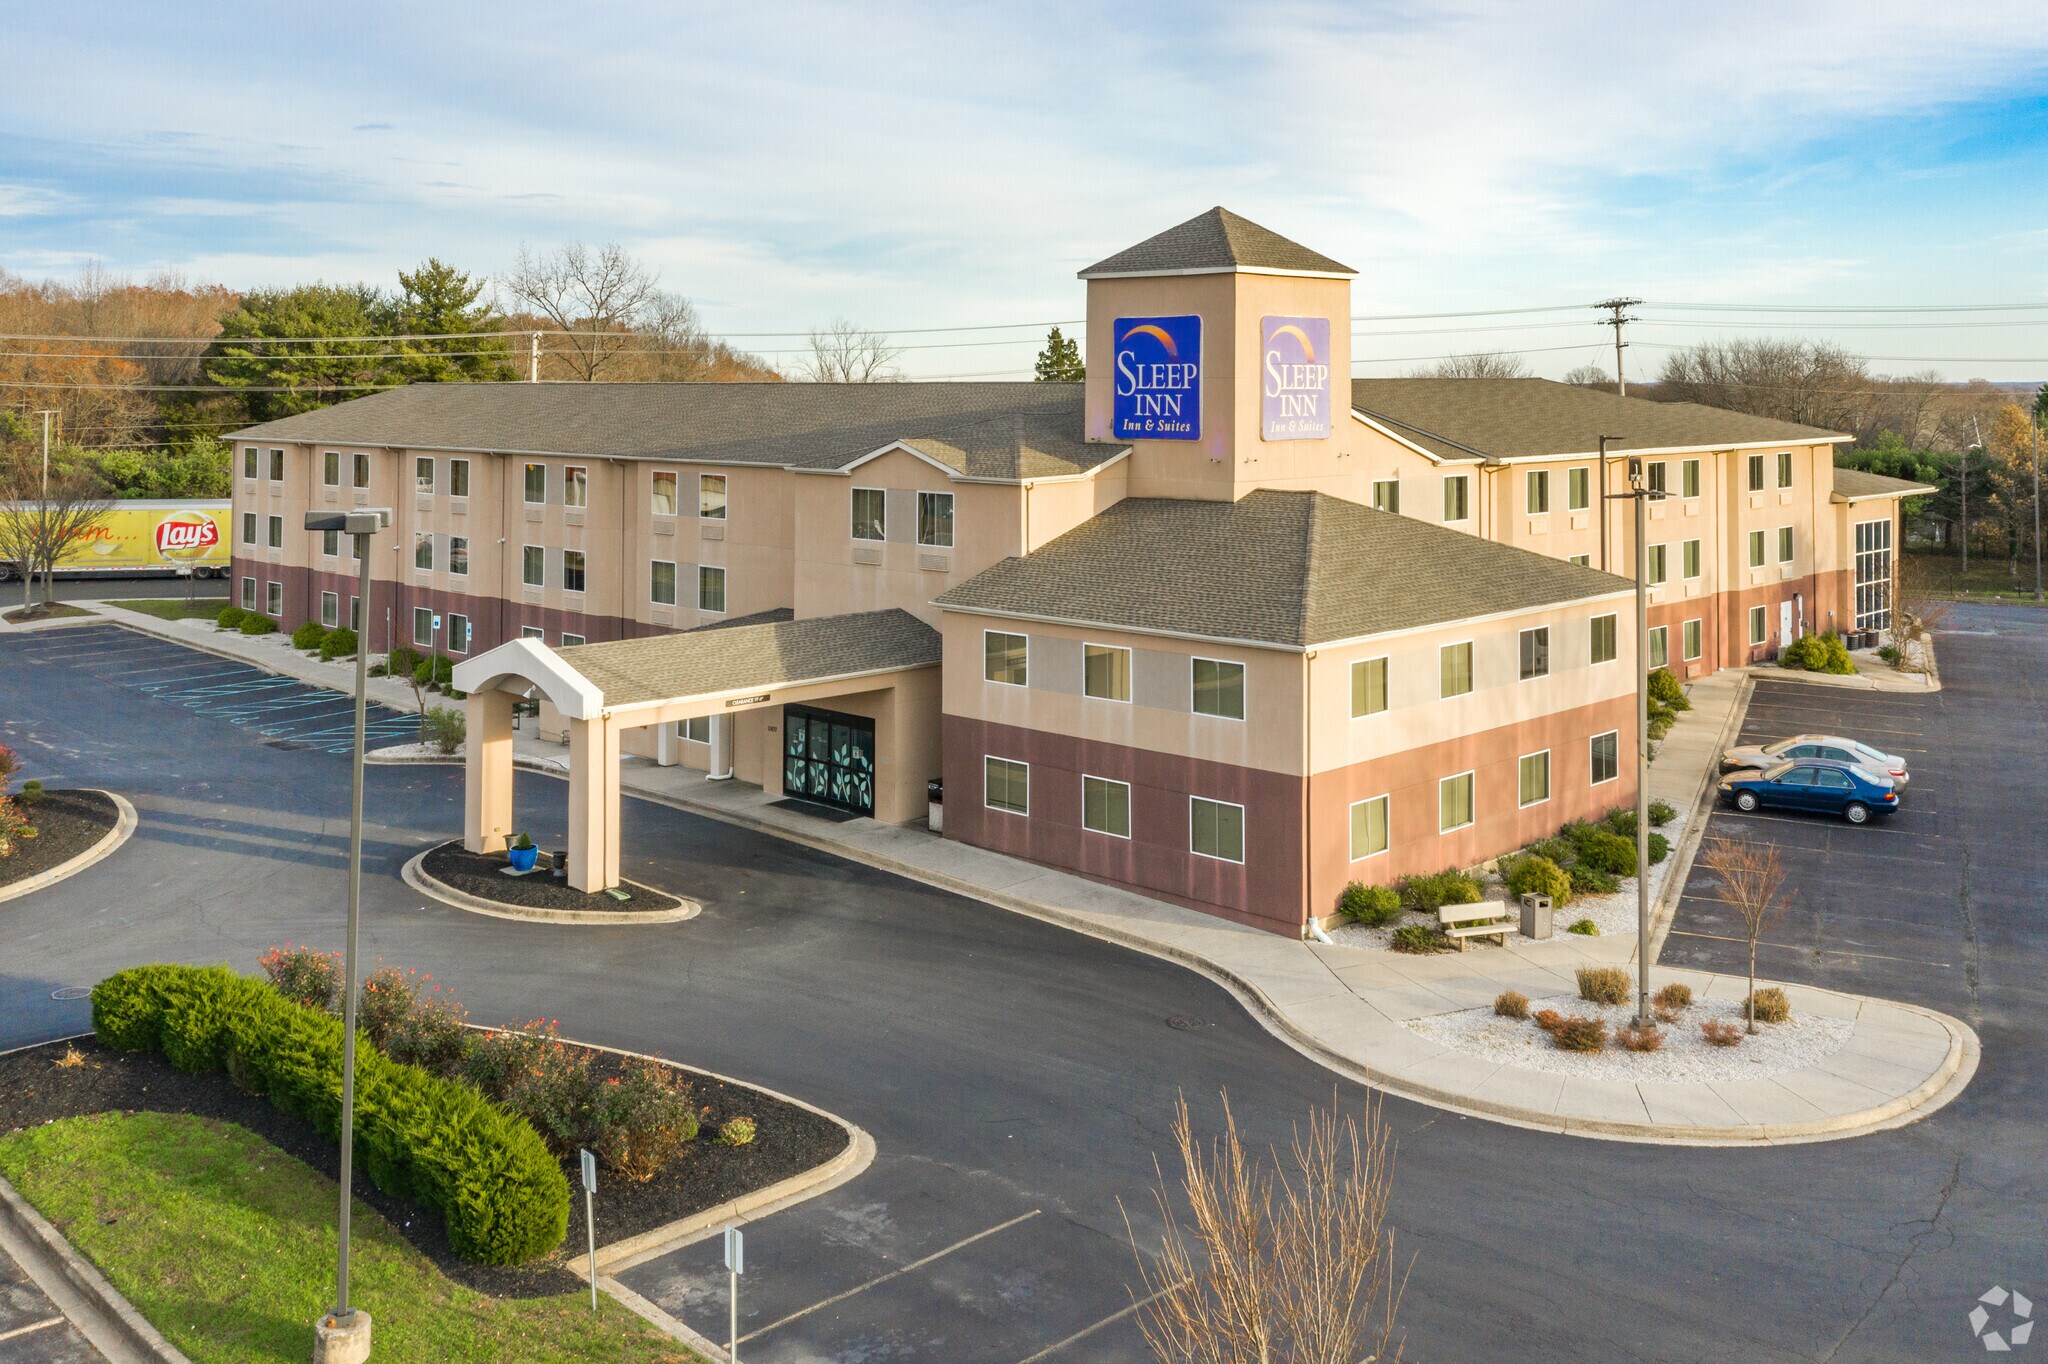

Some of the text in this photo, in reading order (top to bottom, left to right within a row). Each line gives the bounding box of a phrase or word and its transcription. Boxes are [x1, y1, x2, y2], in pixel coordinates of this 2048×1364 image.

[1117, 351, 1197, 396] SLEEP
[1265, 350, 1328, 398] SLEEP
[1134, 394, 1183, 417] INN
[1279, 394, 1318, 418] INN
[1122, 418, 1191, 432] Inn & Suites
[1271, 420, 1324, 433] Inn & Suites
[160, 521, 214, 550] Lay's
